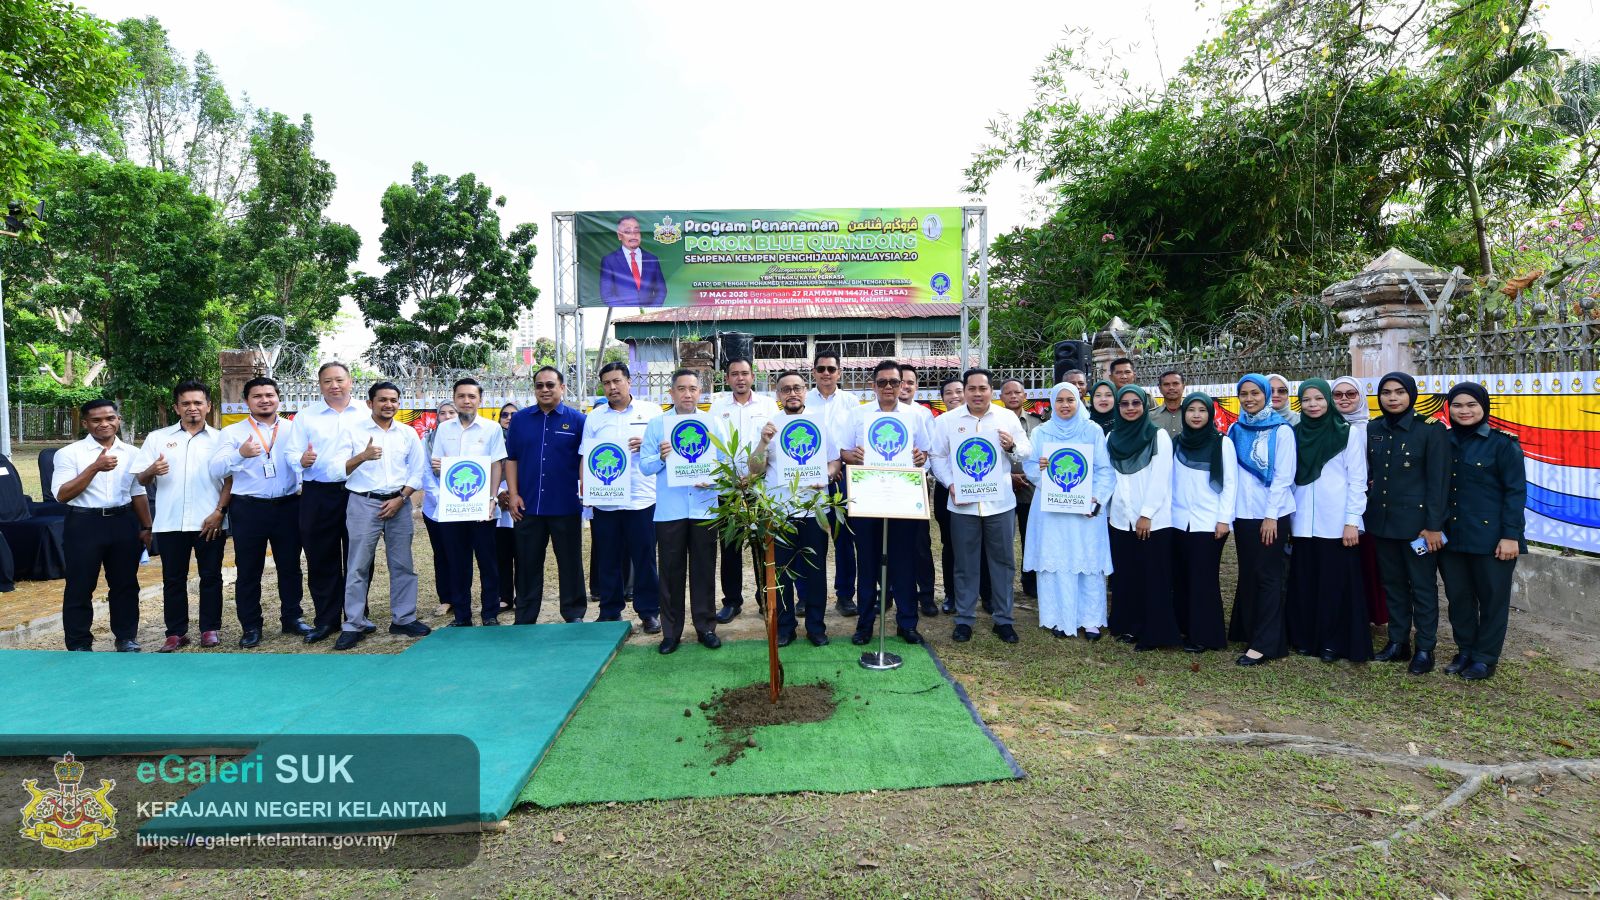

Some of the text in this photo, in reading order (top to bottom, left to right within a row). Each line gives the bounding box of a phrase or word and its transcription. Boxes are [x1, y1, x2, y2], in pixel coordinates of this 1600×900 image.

[684, 218, 839, 236] Program Penanaman
[684, 234, 918, 253] POKOK BLUE QUANDONG
[684, 252, 918, 264] SEMPENA KEMPEN PENGHIJAUAN MALAYSIA 2.0
[870, 289, 908, 297] (SELASA)
[860, 295, 894, 303] Kelantan
[961, 487, 998, 495] MALAYSIA
